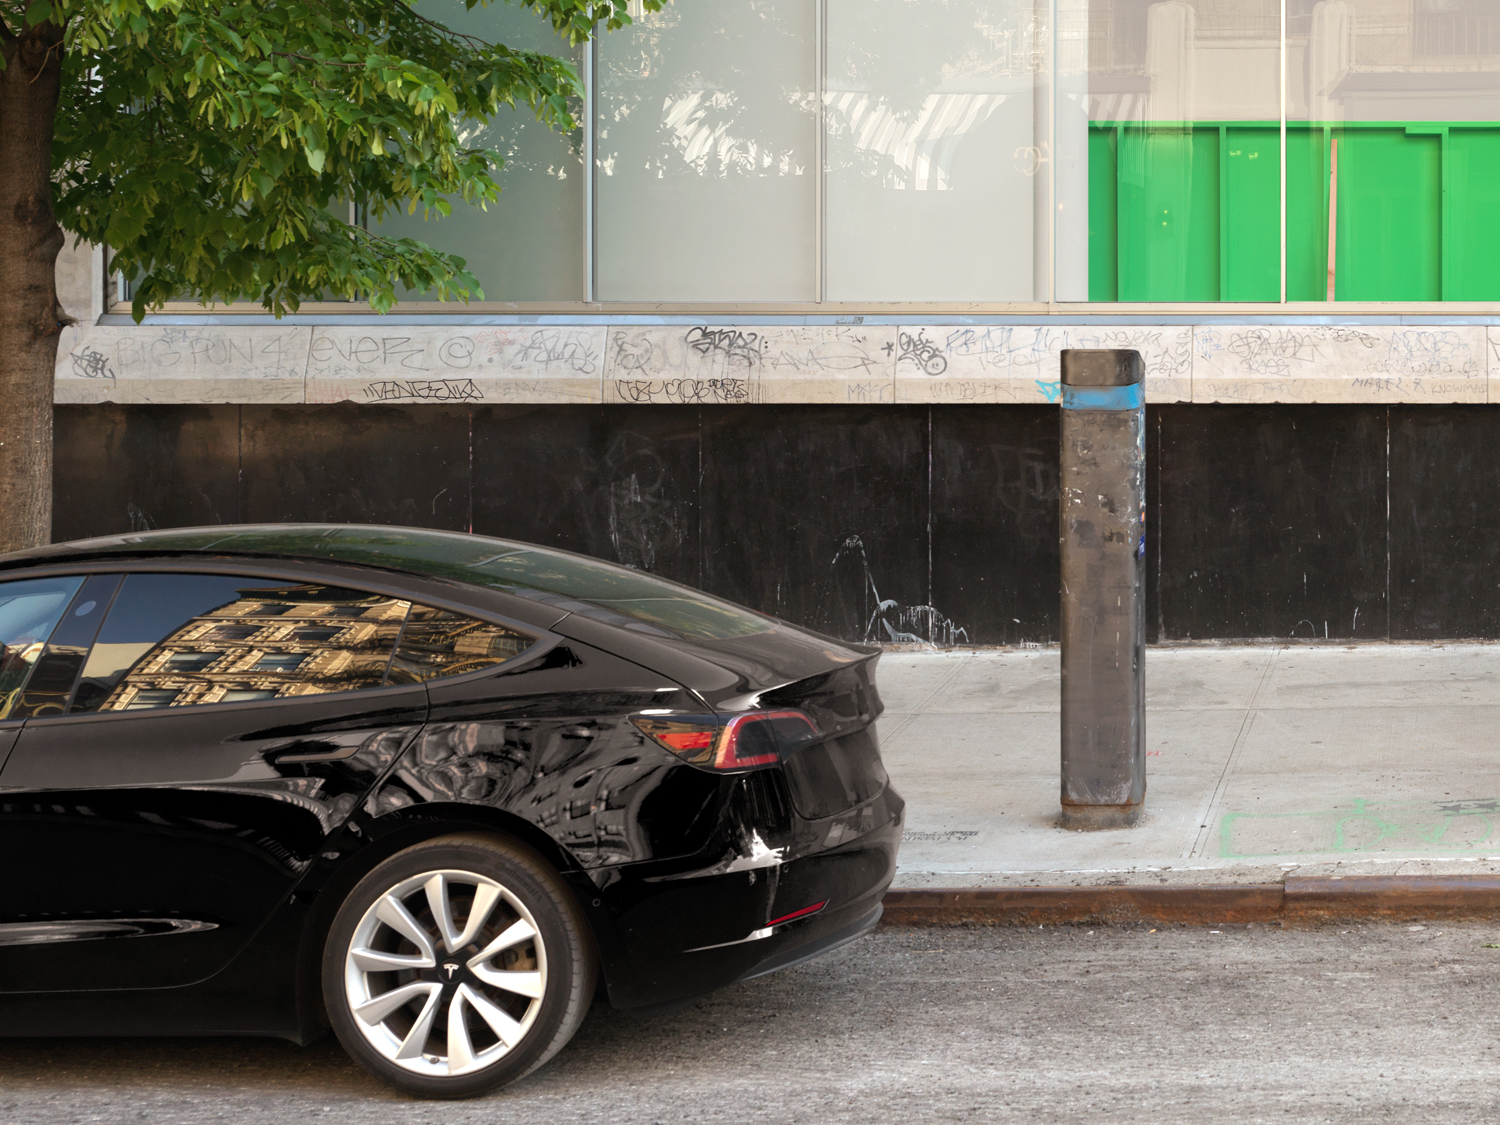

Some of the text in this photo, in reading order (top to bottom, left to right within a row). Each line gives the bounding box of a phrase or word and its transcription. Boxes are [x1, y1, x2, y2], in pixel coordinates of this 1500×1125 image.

[116, 336, 182, 367] BIG
[189, 337, 254, 372] PUN
[1431, 382, 1487, 394] KNOWMAD
